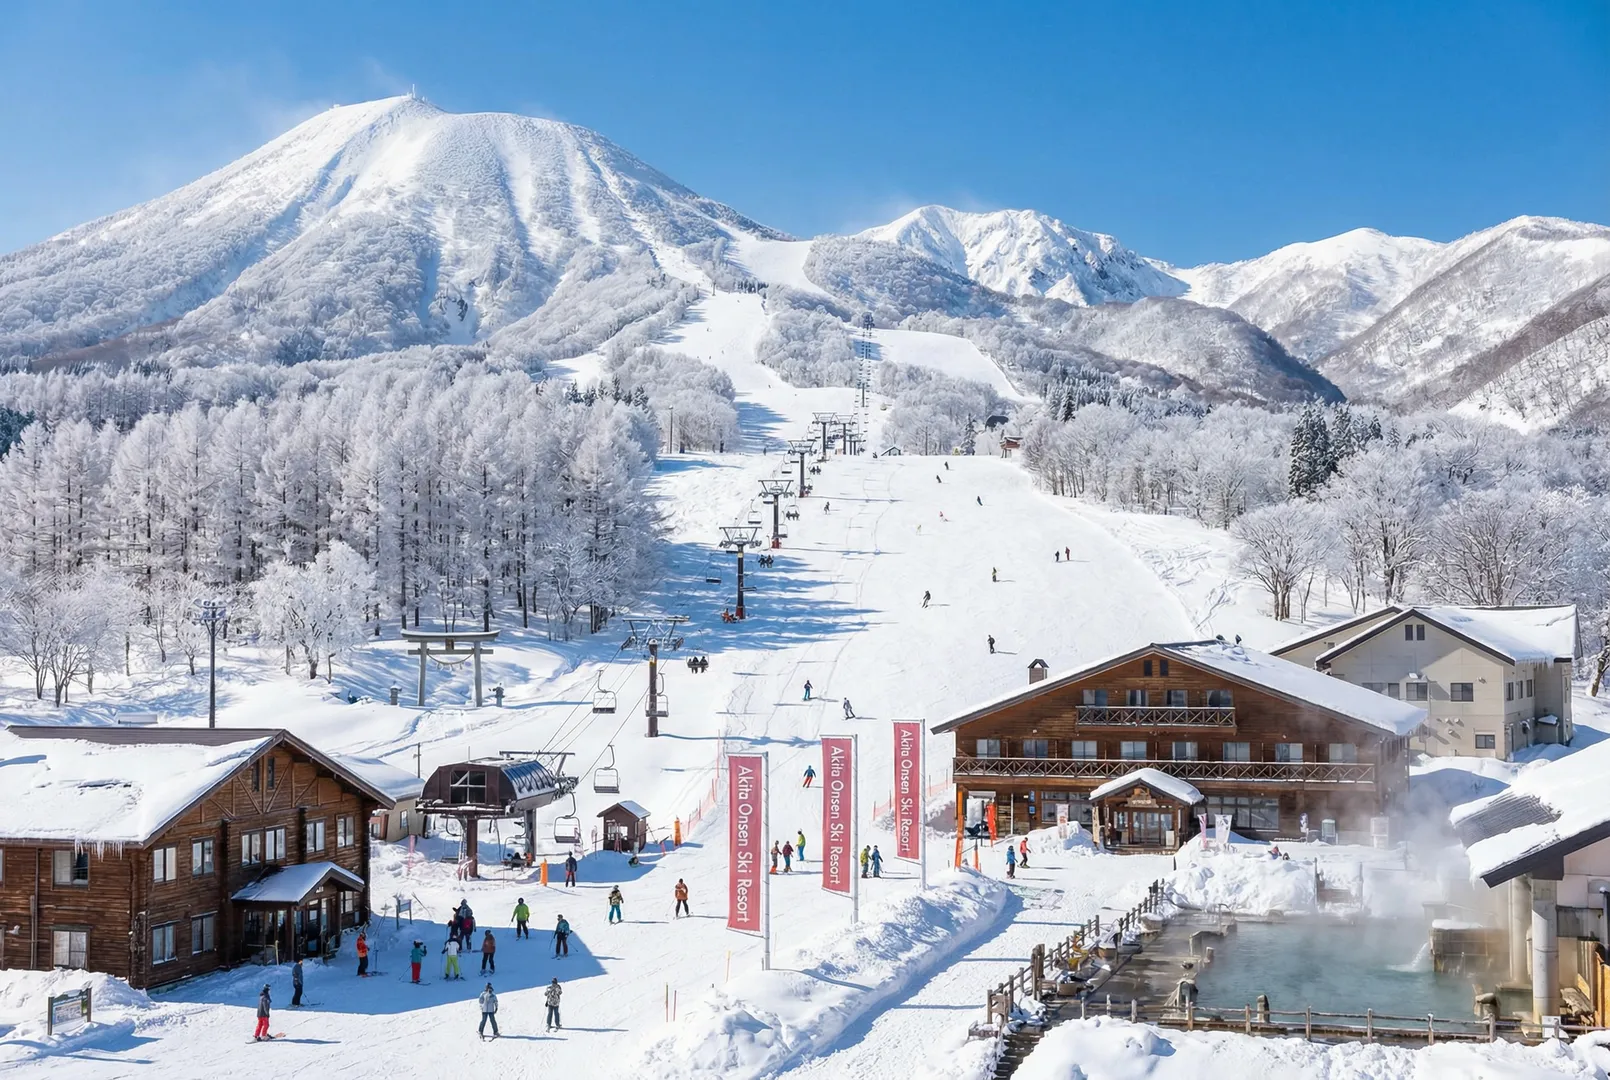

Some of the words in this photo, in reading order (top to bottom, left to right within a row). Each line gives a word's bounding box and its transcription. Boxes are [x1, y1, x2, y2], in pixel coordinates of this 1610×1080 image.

[900, 729, 914, 757] Akita
[831, 745, 845, 777] Akita
[901, 759, 913, 794] Onsen
[738, 765, 753, 799] Akita
[831, 780, 844, 819] Onsen
[901, 797, 913, 815] Ski
[738, 803, 753, 847] Onsen
[830, 822, 844, 842] Ski
[901, 818, 912, 852] Resort
[737, 851, 753, 873] Ski
[830, 846, 843, 885] Resort
[737, 878, 752, 923] Resort
